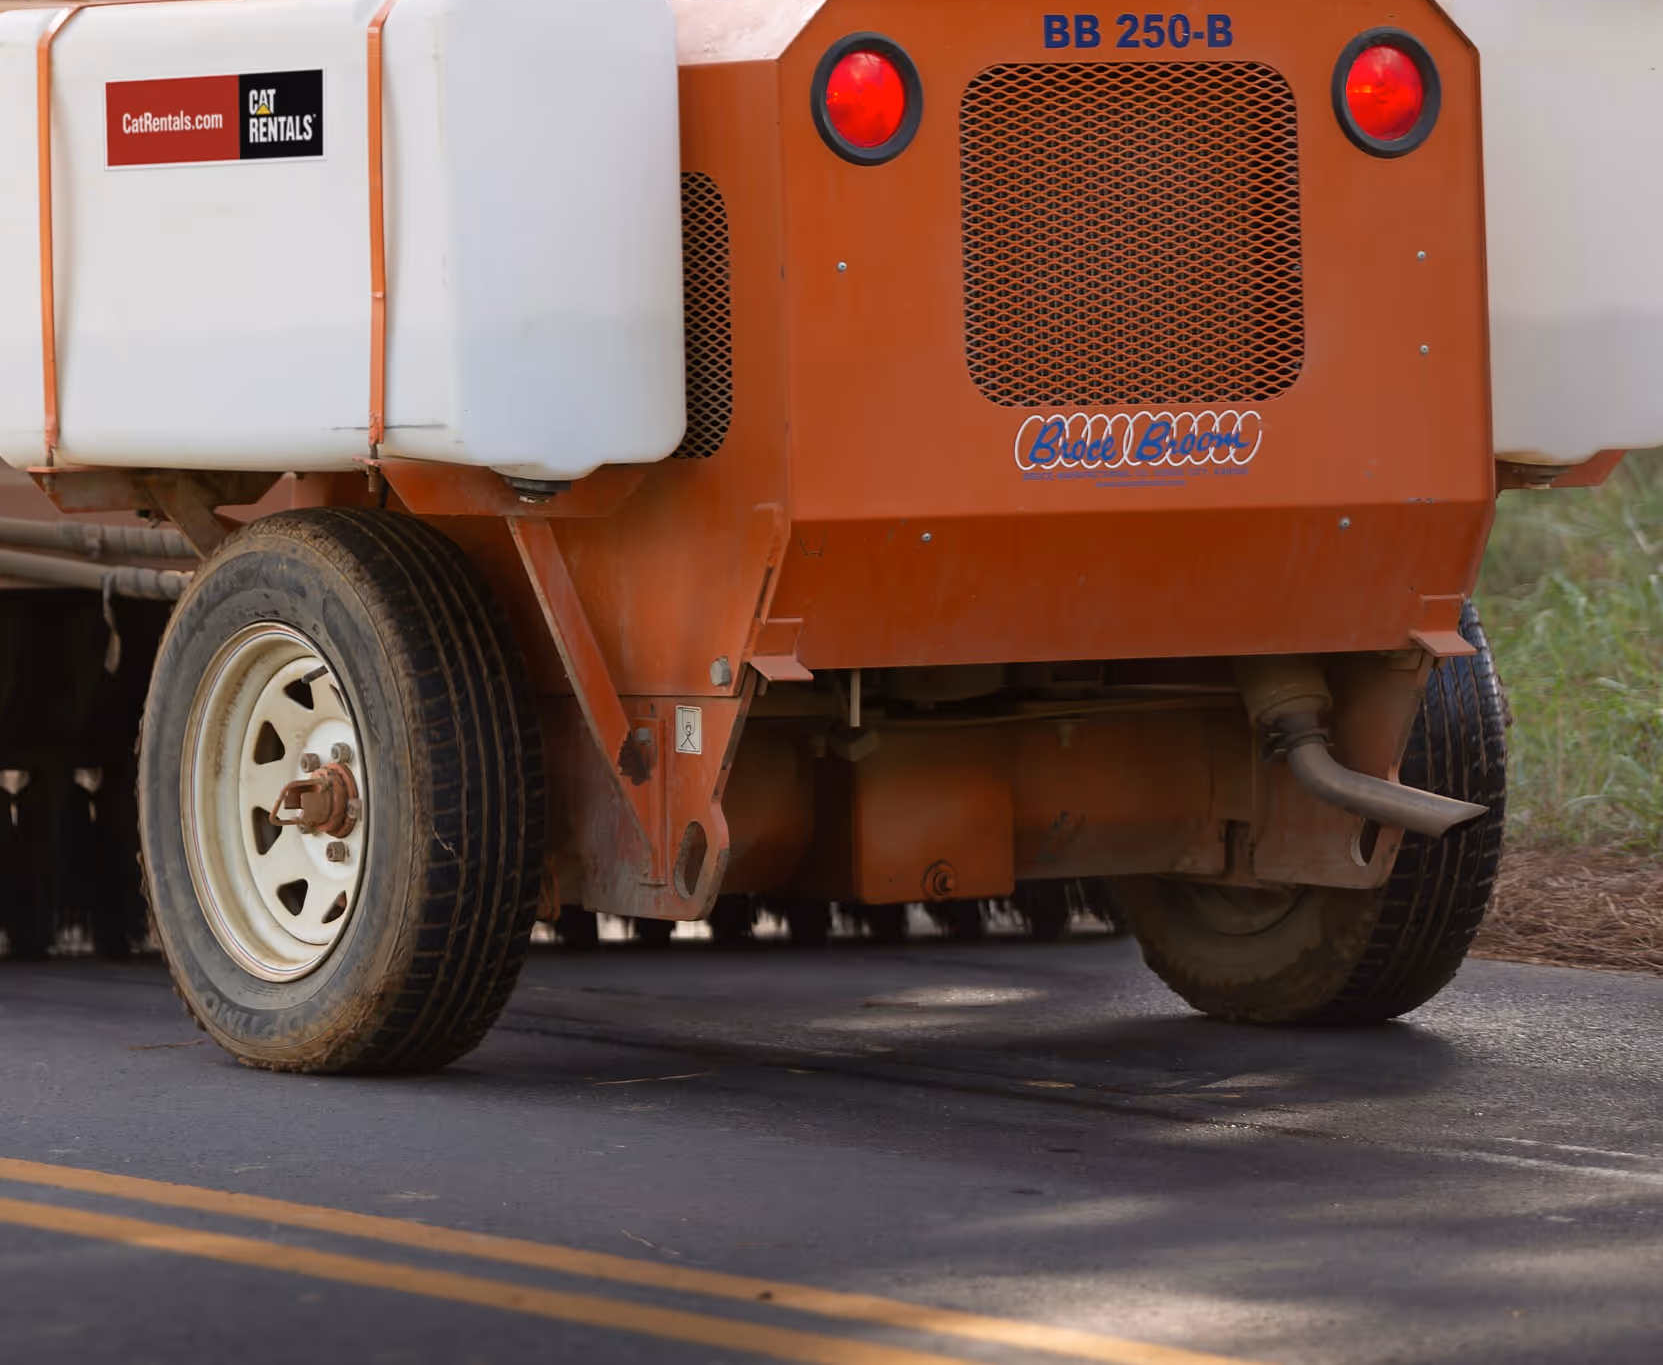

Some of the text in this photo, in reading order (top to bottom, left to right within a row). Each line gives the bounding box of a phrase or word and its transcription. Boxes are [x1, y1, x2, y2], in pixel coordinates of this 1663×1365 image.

[1043, 14, 1233, 48] BB 250-B
[249, 88, 276, 115] CAT
[122, 110, 223, 135] CatRentals.com
[249, 114, 313, 143] RENTALS
[1028, 421, 1250, 463] Broce Broom
